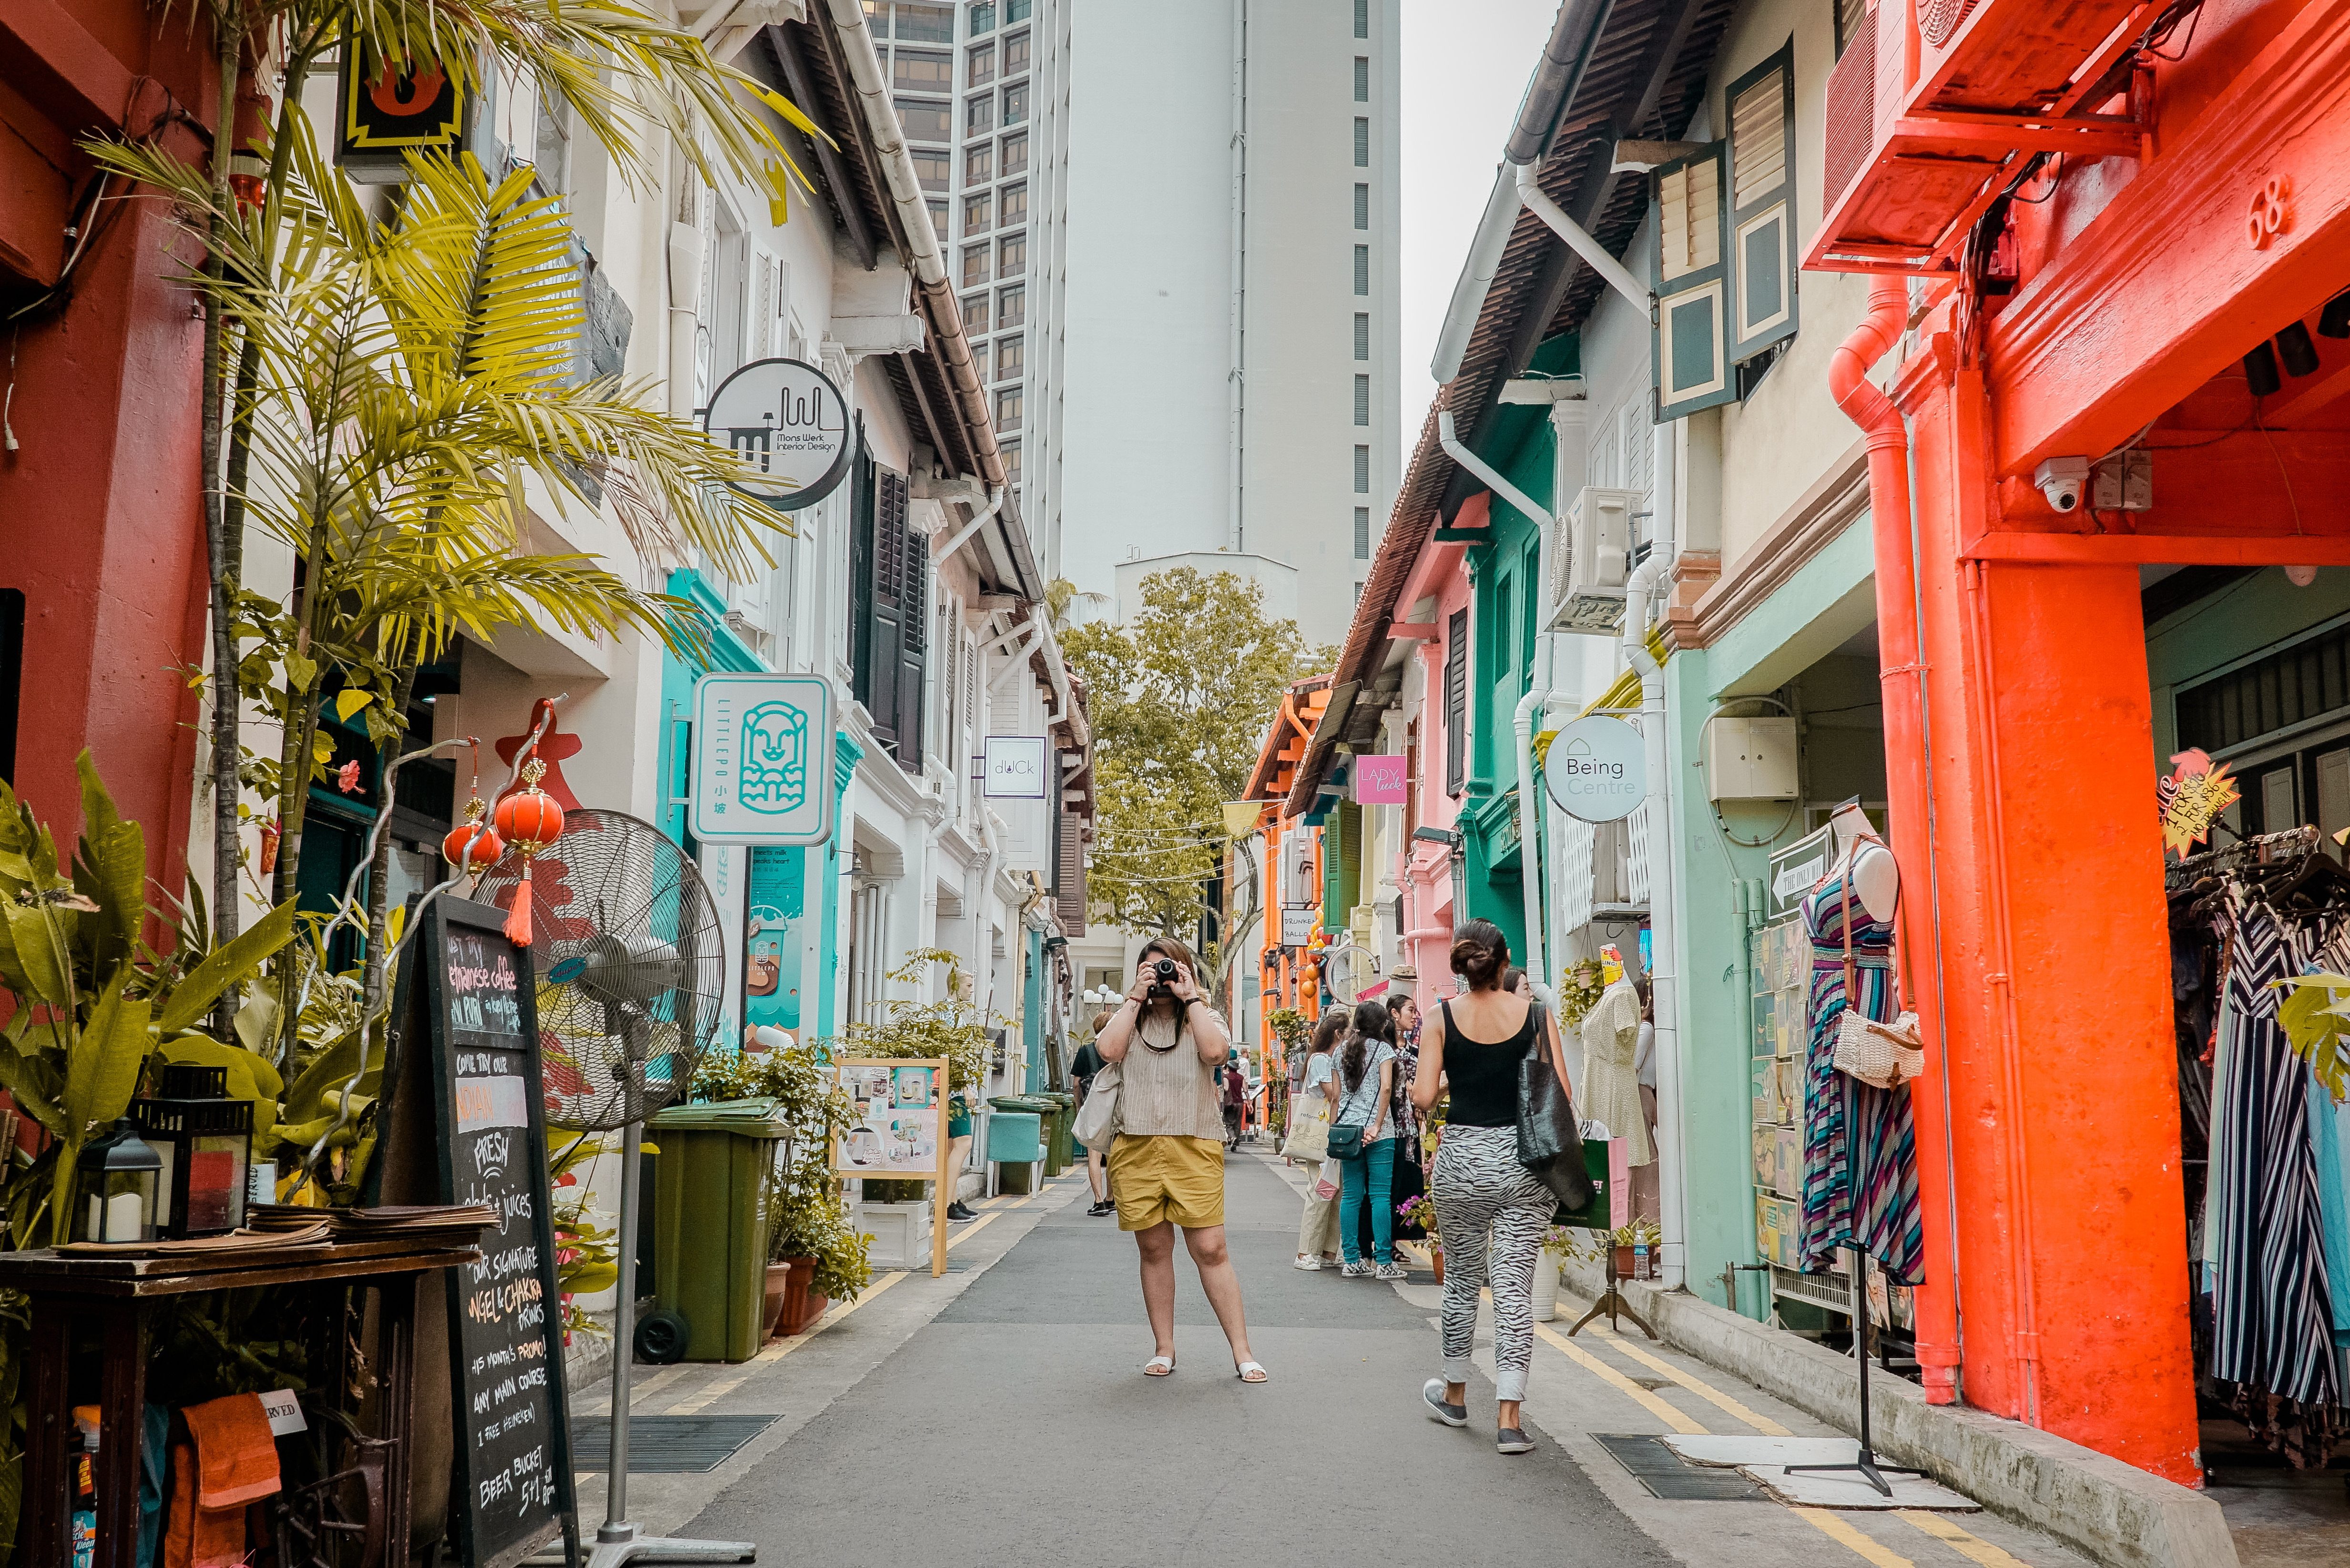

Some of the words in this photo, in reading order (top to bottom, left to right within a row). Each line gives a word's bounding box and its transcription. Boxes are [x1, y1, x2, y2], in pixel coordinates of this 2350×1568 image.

[2245, 173, 2291, 251] 68
[808, 442, 835, 453] Design
[715, 699, 731, 776] LITTLEPO
[1361, 768, 1399, 781] LADY
[1567, 759, 1623, 779] Being
[1376, 776, 1404, 792] luck
[1567, 778, 1636, 794] Centre
[714, 785, 727, 815] 小坡
[2170, 792, 2193, 816] FOR
[2177, 825, 2188, 836] 2
[2184, 803, 2207, 822] FOR
[2200, 782, 2220, 803] $36
[2165, 816, 2179, 829] 1
[2190, 823, 2204, 836] NO
[1783, 874, 1795, 892] THE
[1797, 867, 1809, 887] ONLY
[493, 1056, 508, 1073] OUR
[456, 1085, 494, 1123] NDIAN
[500, 1184, 531, 1235] juices
[493, 1246, 538, 1280] SIGNATURE
[505, 1277, 542, 1313] CHAKRA
[518, 1303, 544, 1331] DRINKS
[487, 1343, 516, 1368] MONTH'S
[518, 1334, 547, 1361] PROMO!
[474, 1388, 490, 1415] ANY
[494, 1376, 516, 1405] MAIN
[519, 1367, 547, 1390] COURSE
[266, 1404, 295, 1419] RVED
[480, 1468, 513, 1509] BEER
[514, 1445, 542, 1476] BUCKET
